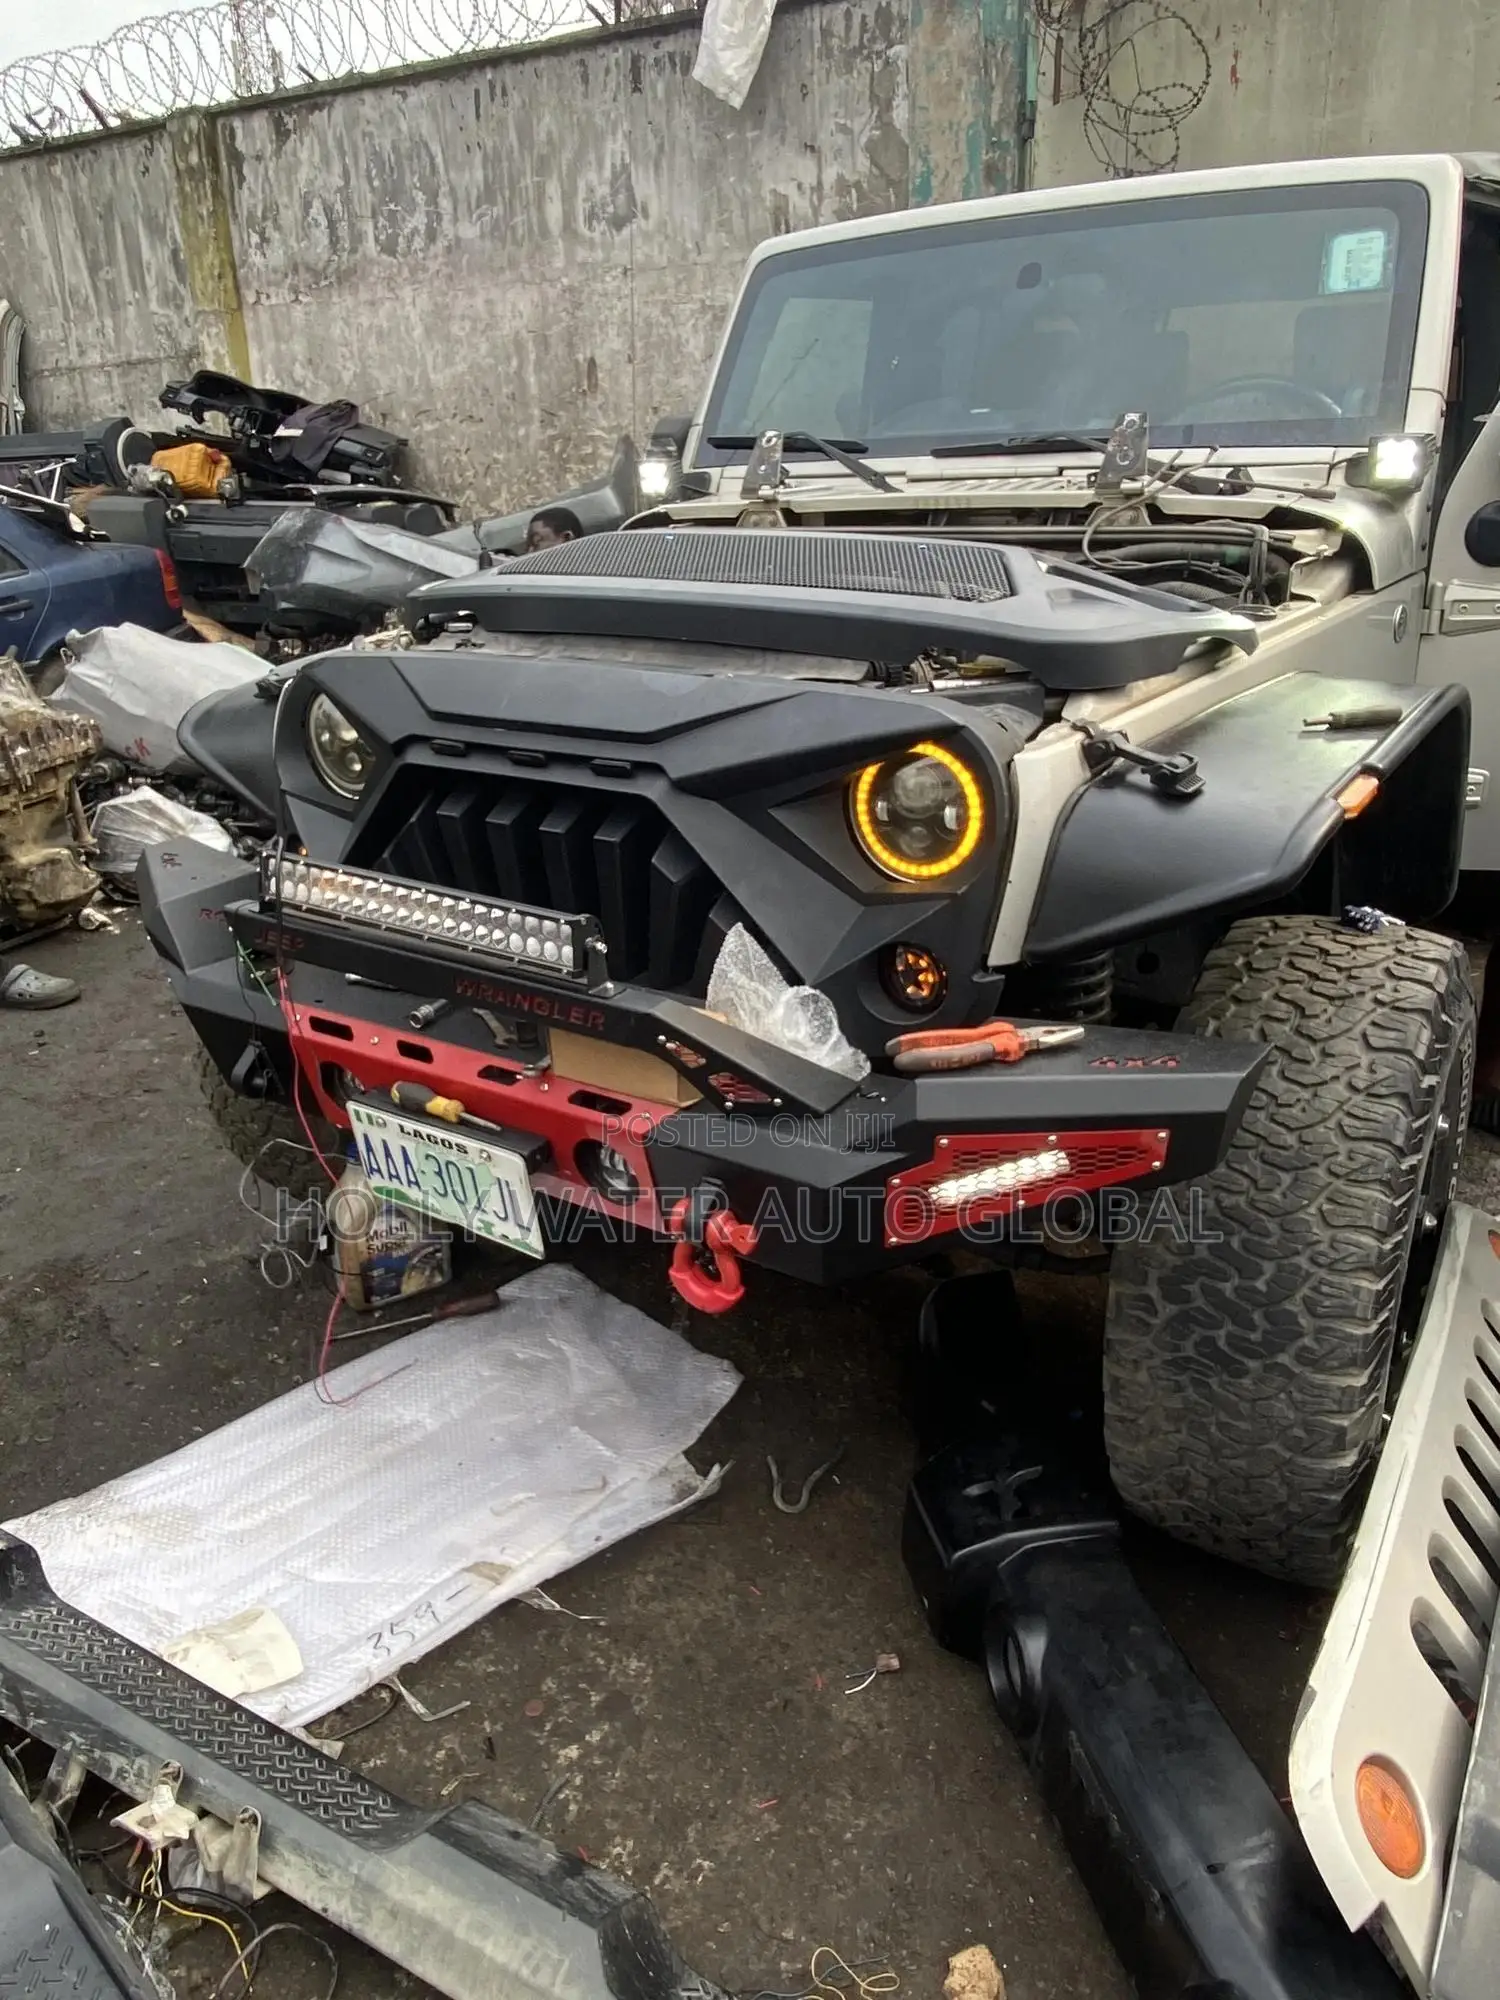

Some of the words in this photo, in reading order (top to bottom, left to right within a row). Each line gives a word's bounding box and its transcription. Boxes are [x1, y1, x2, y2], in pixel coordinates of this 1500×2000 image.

[254, 927, 305, 951] JEEP
[454, 975, 606, 1031] WRANGLER
[398, 1123, 469, 1155] LAGOS
[365, 1220, 408, 1243] Mobil
